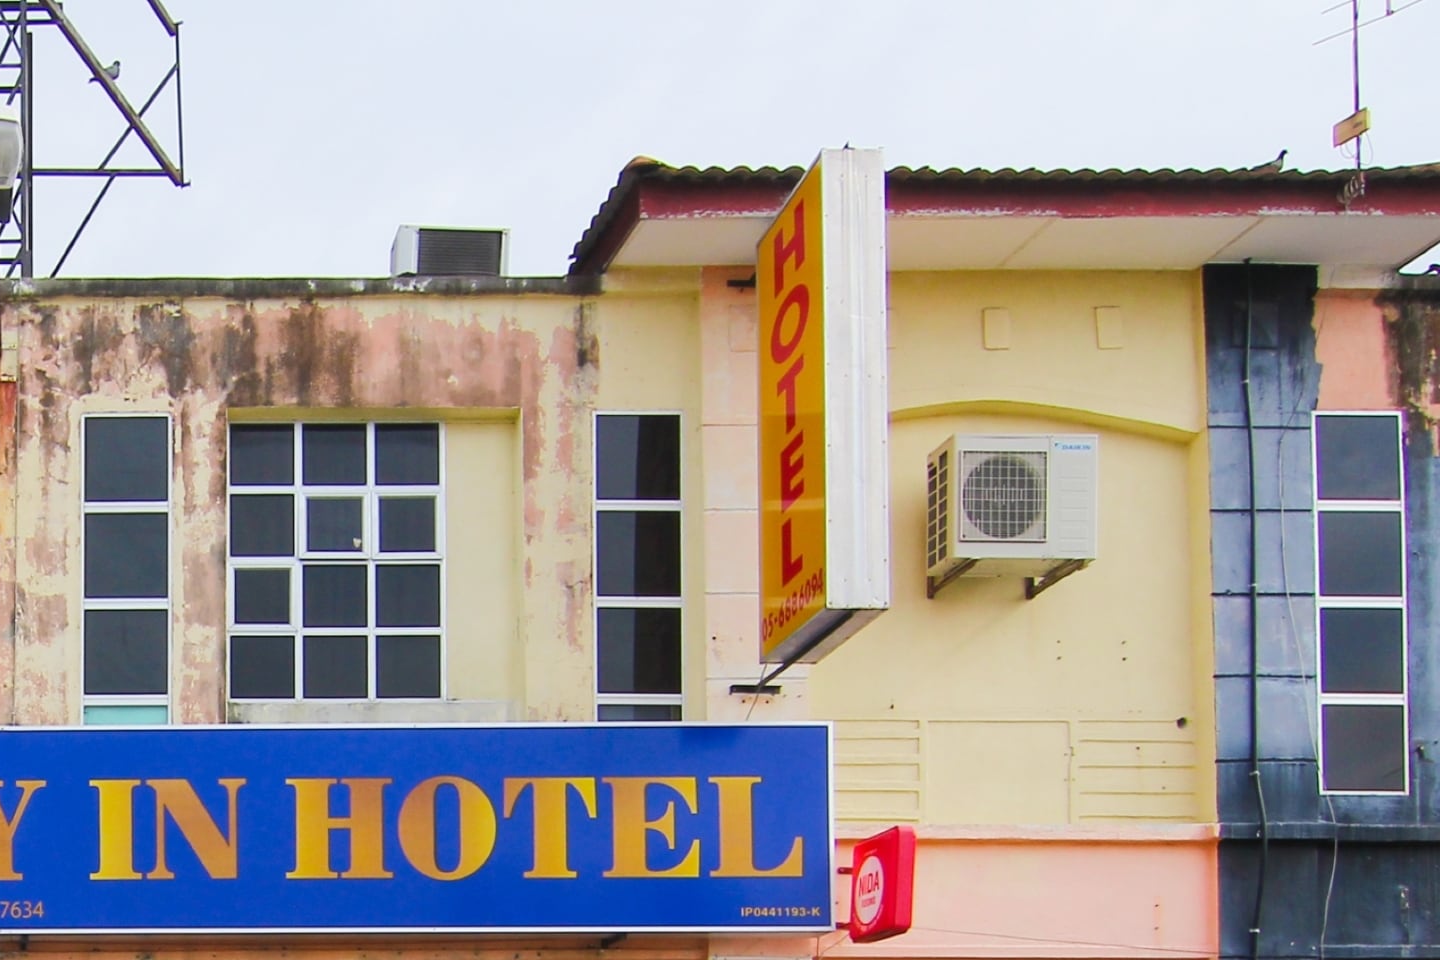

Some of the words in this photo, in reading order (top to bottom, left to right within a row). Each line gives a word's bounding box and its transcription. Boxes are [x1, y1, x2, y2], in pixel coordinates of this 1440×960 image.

[770, 198, 810, 588] HOTEL
[762, 567, 824, 642] 05-6886094
[89, 777, 247, 881] IN
[285, 775, 804, 881] HOTEL
[741, 907, 821, 917] IP0441193-K
[858, 871, 880, 897] NIDA
